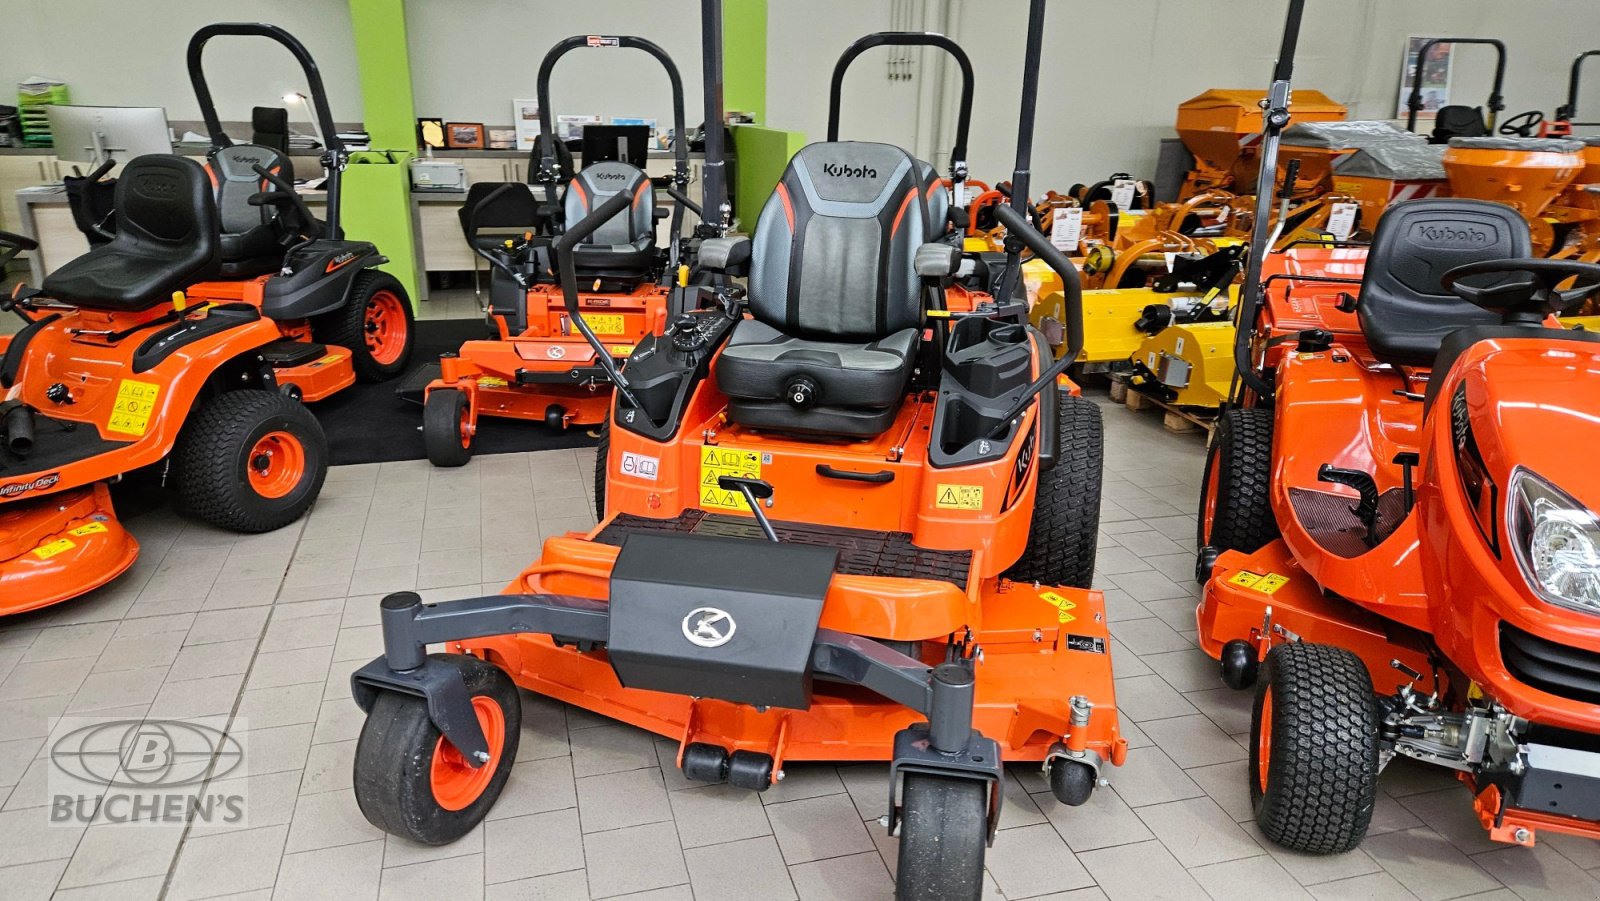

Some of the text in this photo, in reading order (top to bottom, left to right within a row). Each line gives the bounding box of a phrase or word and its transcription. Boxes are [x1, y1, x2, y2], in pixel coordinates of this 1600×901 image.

[596, 172, 626, 181] Kubota
[823, 163, 877, 179] Kubota
[1419, 226, 1487, 241] Kubota
[1452, 390, 1469, 451] Kubota
